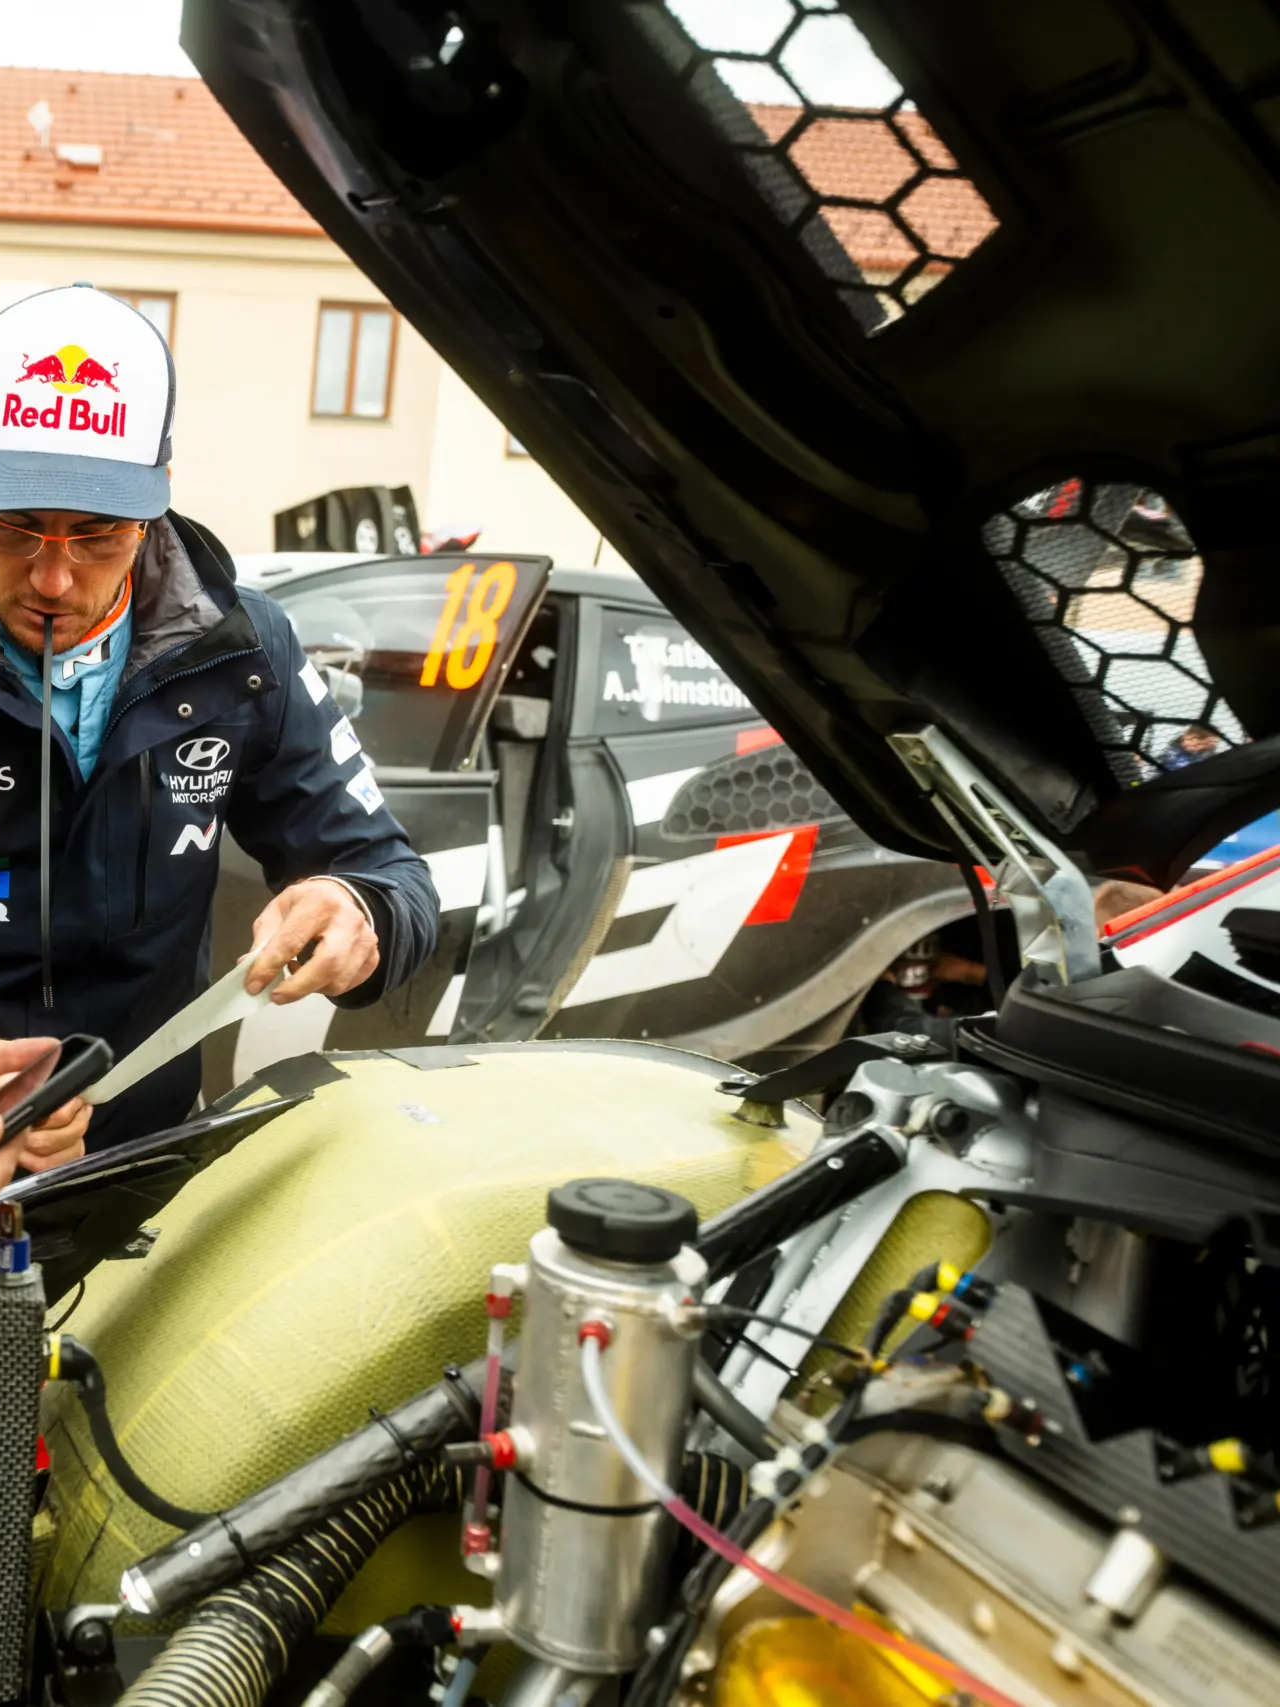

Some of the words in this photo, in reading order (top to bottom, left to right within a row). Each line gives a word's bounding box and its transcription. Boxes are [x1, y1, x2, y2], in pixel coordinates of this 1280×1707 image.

[2, 393, 63, 429] Red
[69, 398, 127, 437] Bull
[420, 561, 517, 690] 18
[169, 770, 233, 790] HYUNDAI
